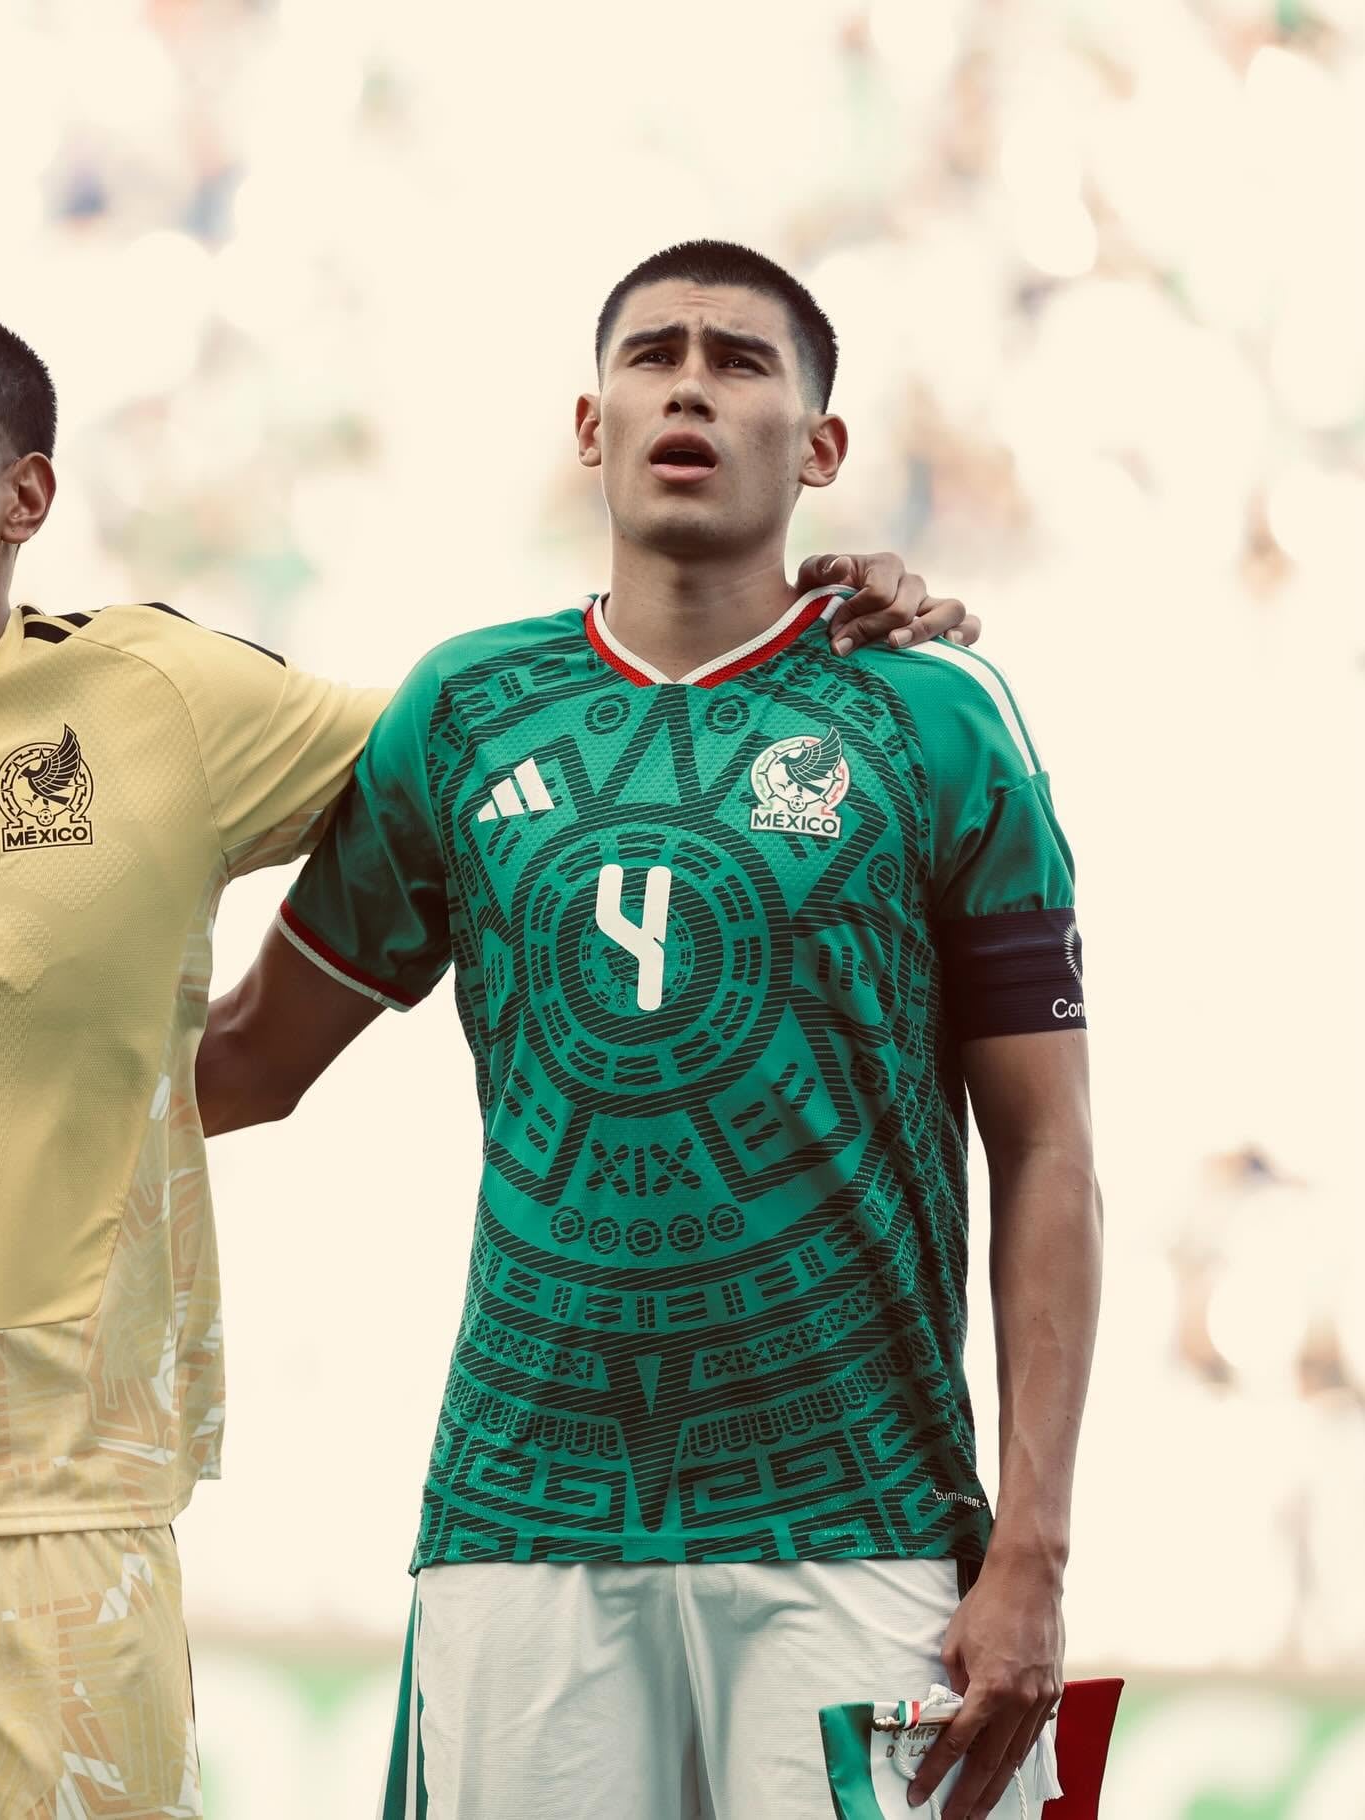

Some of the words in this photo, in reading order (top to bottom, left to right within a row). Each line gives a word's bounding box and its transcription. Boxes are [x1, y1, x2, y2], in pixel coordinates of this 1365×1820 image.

[753, 810, 838, 834] MÉXICO
[6, 826, 88, 847] MÉXICO
[595, 863, 672, 1011] 4
[1051, 998, 1084, 1019] Con
